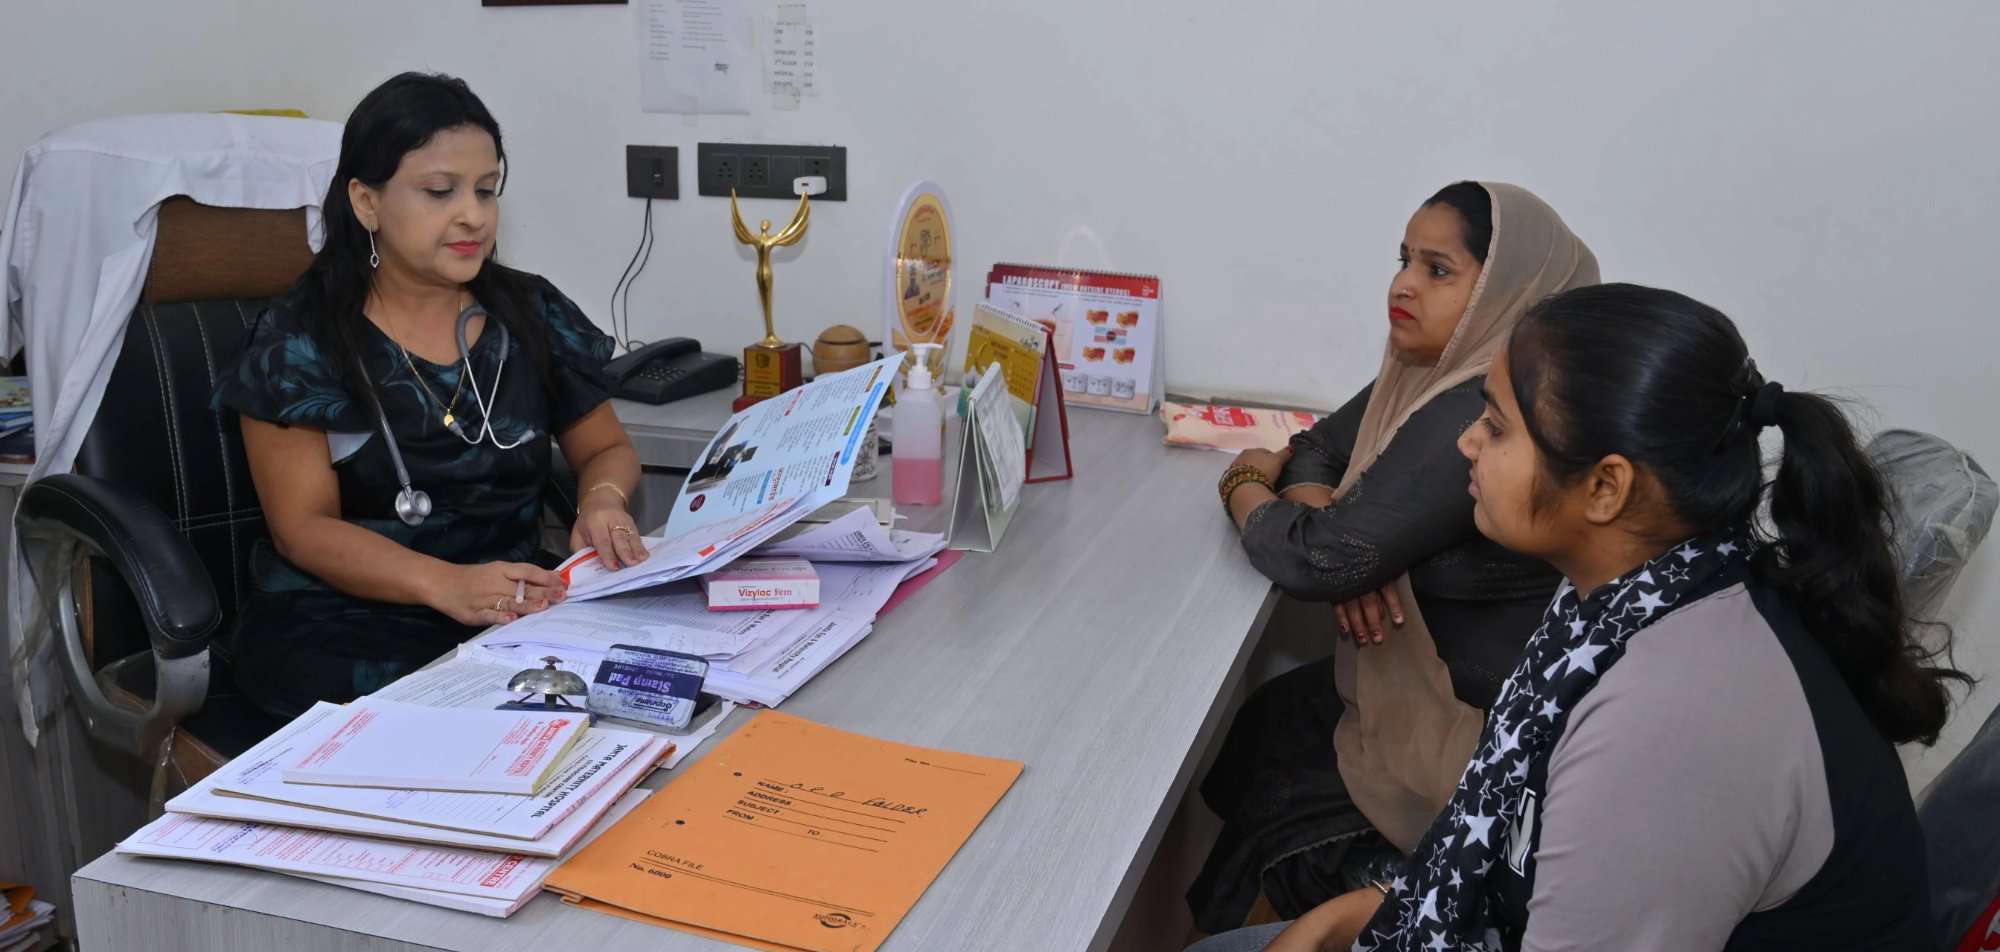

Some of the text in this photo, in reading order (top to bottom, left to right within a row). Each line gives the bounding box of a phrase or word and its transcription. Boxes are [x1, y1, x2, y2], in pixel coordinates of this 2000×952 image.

[1003, 275, 1060, 289] LAPAROSCOPY
[738, 588, 793, 599] Vizylac Fem
[608, 672, 632, 686] Pad
[634, 674, 672, 693] Stamp
[635, 697, 673, 712] Supreme
[530, 744, 628, 818] JANTA MATERNITY HOSPITAL
[647, 849, 704, 871] COBRA FILE
[486, 859, 519, 887] CENTRE
[628, 862, 672, 879] No. 6000
